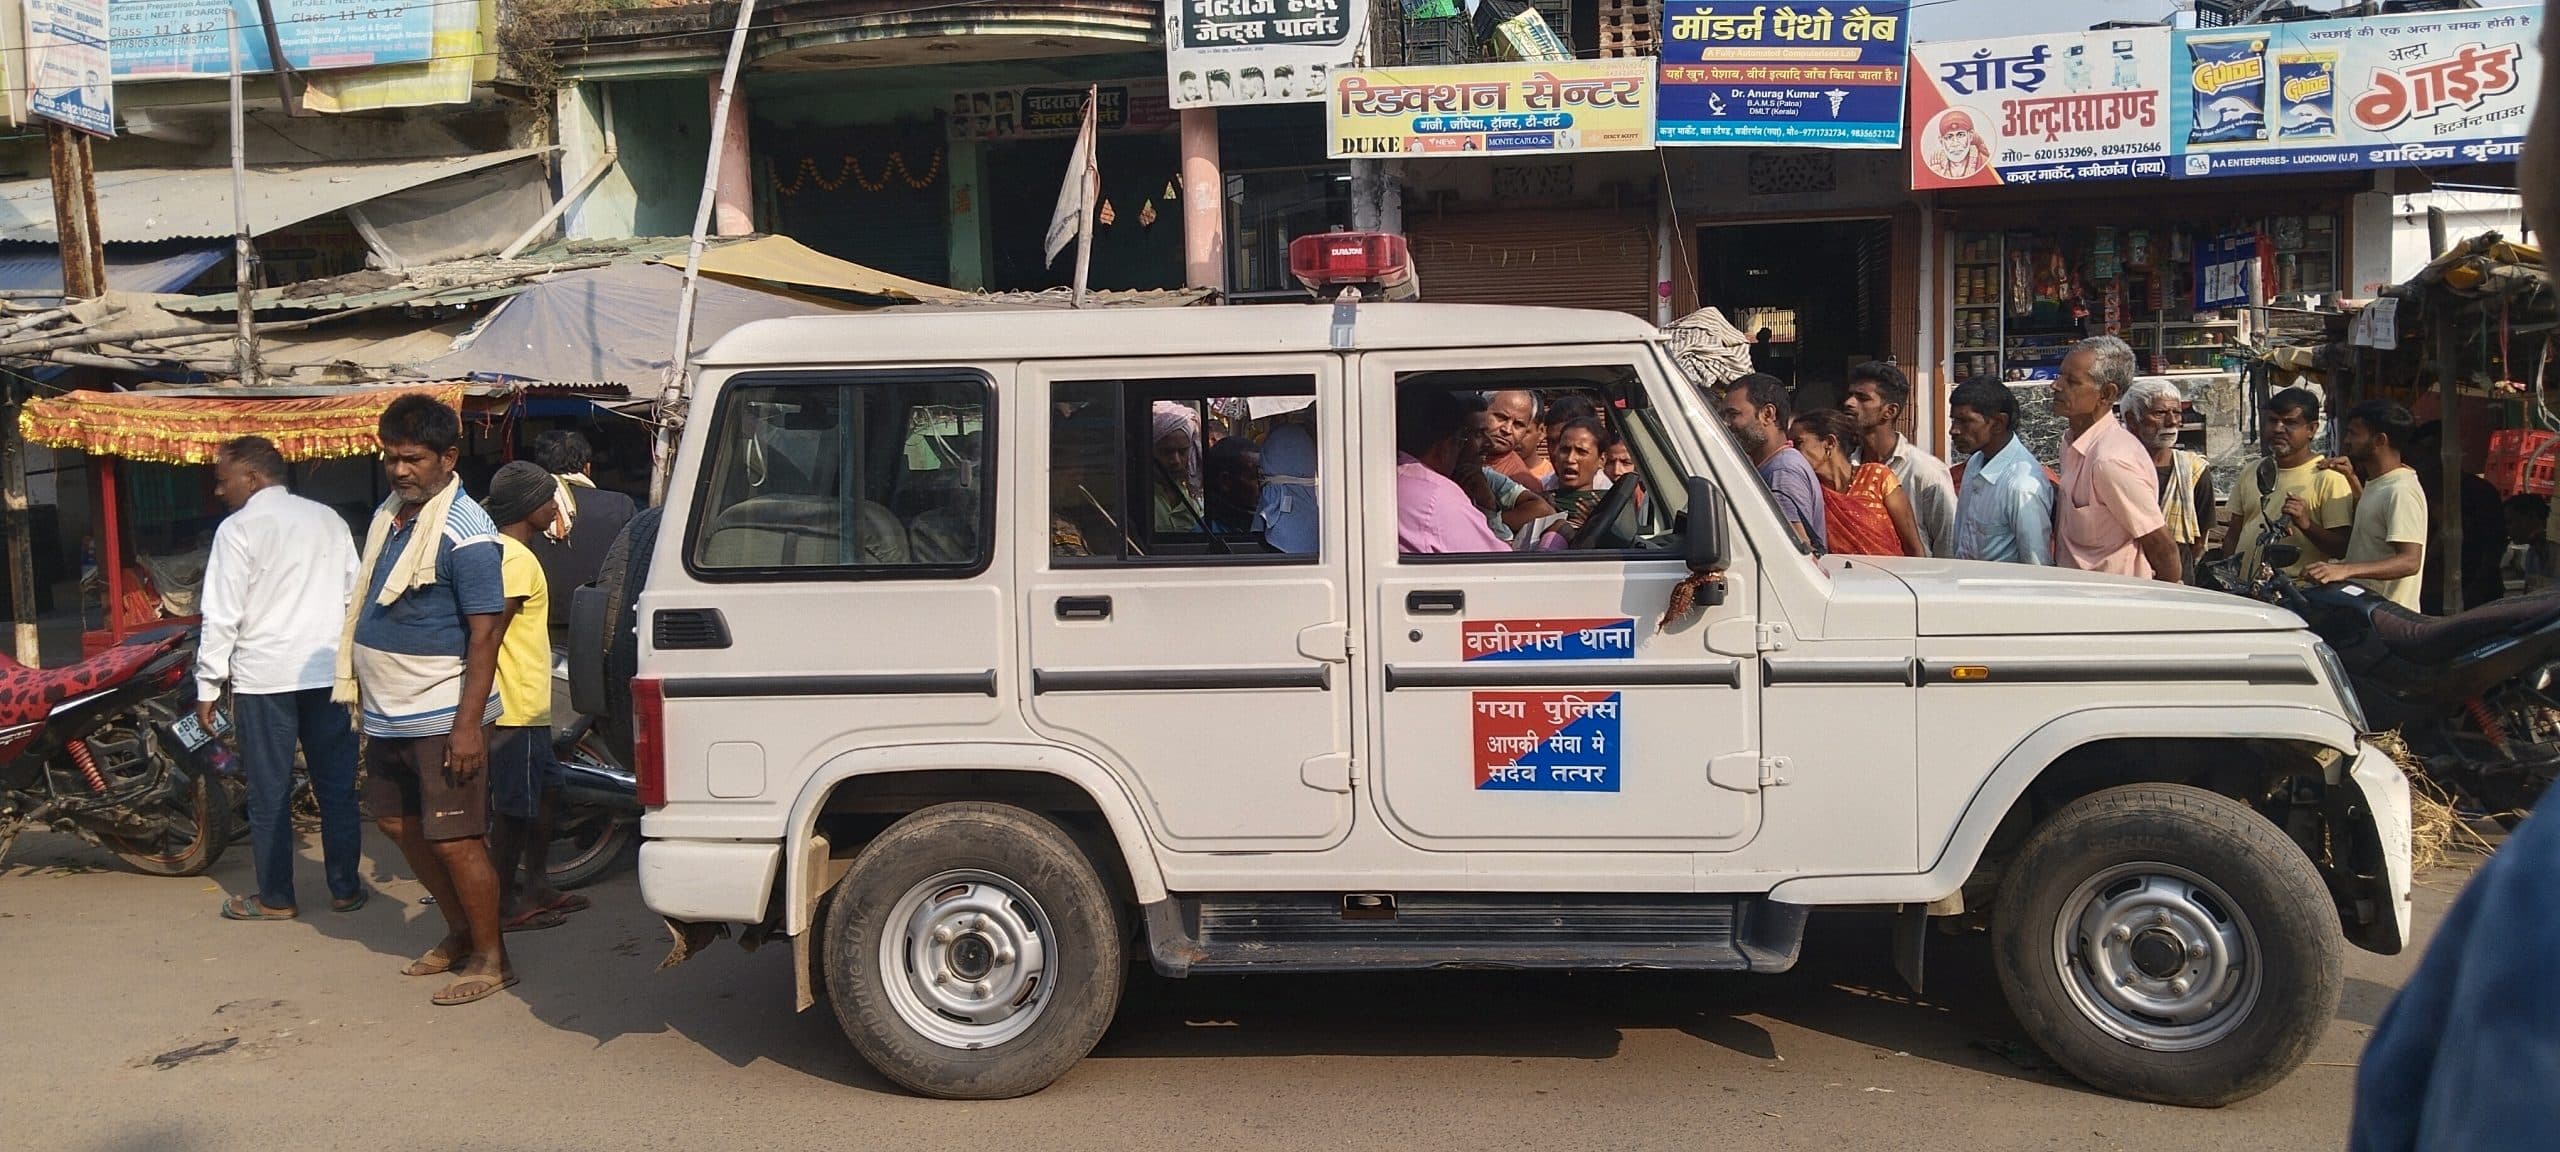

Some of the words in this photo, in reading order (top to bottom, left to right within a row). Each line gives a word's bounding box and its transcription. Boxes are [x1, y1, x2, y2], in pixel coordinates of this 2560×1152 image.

[147, 1, 194, 12] Preparation
[151, 10, 176, 19] NEET
[185, 7, 228, 17] BOARDS
[1193, 0, 1276, 17] नटराज
[109, 27, 142, 37] Class
[1193, 19, 1266, 44] जेन्ट्स
[1273, 12, 1340, 37] पार्लर
[1671, 6, 1766, 41] मॉडर्न
[1773, 6, 1834, 41] पैथो
[1842, 6, 1898, 42] लैब
[2309, 26, 2353, 41] अच्छाई
[2357, 26, 2374, 38] की
[2379, 26, 2401, 36] एक
[2407, 24, 2441, 35] अलग
[2448, 21, 2481, 31] चमक
[2487, 17, 2516, 29] होती
[2519, 15, 2531, 27] है
[110, 38, 150, 48] PHYSICS
[162, 34, 217, 47] CHEMISTRY
[1716, 49, 1735, 58] Fully
[1738, 49, 1779, 57] Automated
[1782, 49, 1839, 57] Computerised
[1841, 49, 1857, 57] Lab
[2389, 42, 2429, 62] अल्ट्रा
[1769, 67, 1801, 82] इत्यादि
[1829, 67, 1855, 80] किया
[1858, 69, 1883, 80] जाता
[2194, 58, 2260, 92] GUIDE
[1338, 76, 1511, 115] रिडक्शन
[1522, 72, 1645, 110] सेन्टर
[1731, 89, 1745, 98] Dr.
[1747, 89, 1784, 100] Anurag
[1786, 89, 1820, 99] Kumar
[2285, 77, 2329, 101] GUIDE
[2354, 46, 2513, 124] गाईड
[1747, 99, 1775, 107] B.A.M.S
[1776, 100, 1803, 108] (Patna)
[1749, 107, 1770, 115] DMLT
[1771, 108, 1799, 116] (Kerala)
[2485, 104, 2526, 122] पाउडर
[2001, 90, 2159, 142] अल्ट्रासाउण्ड
[1342, 136, 1400, 153] DUKE
[1488, 137, 1516, 147] MONTE
[1517, 136, 1539, 146] CARLO
[2034, 147, 2098, 161] 6201532969,
[2101, 141, 2162, 155] 8294752646
[2369, 142, 2456, 163] शालिन
[2078, 161, 2129, 177] वजीरगंज
[2131, 158, 2166, 177] (गया)
[2293, 153, 2337, 164] LUCKNOW
[2339, 153, 2359, 164] (U.P)
[1465, 622, 1564, 653] वजीरगंज
[1579, 627, 1632, 650] थाना
[1476, 700, 1526, 719] गया
[1543, 694, 1618, 725] पुलिस
[1486, 729, 1539, 754] आपकी
[1549, 729, 1582, 754] सेवा
[1592, 729, 1605, 755] मे
[1487, 758, 1537, 783] सदैव
[1550, 765, 1606, 783] तत्पर
[844, 897, 870, 958] SUV
